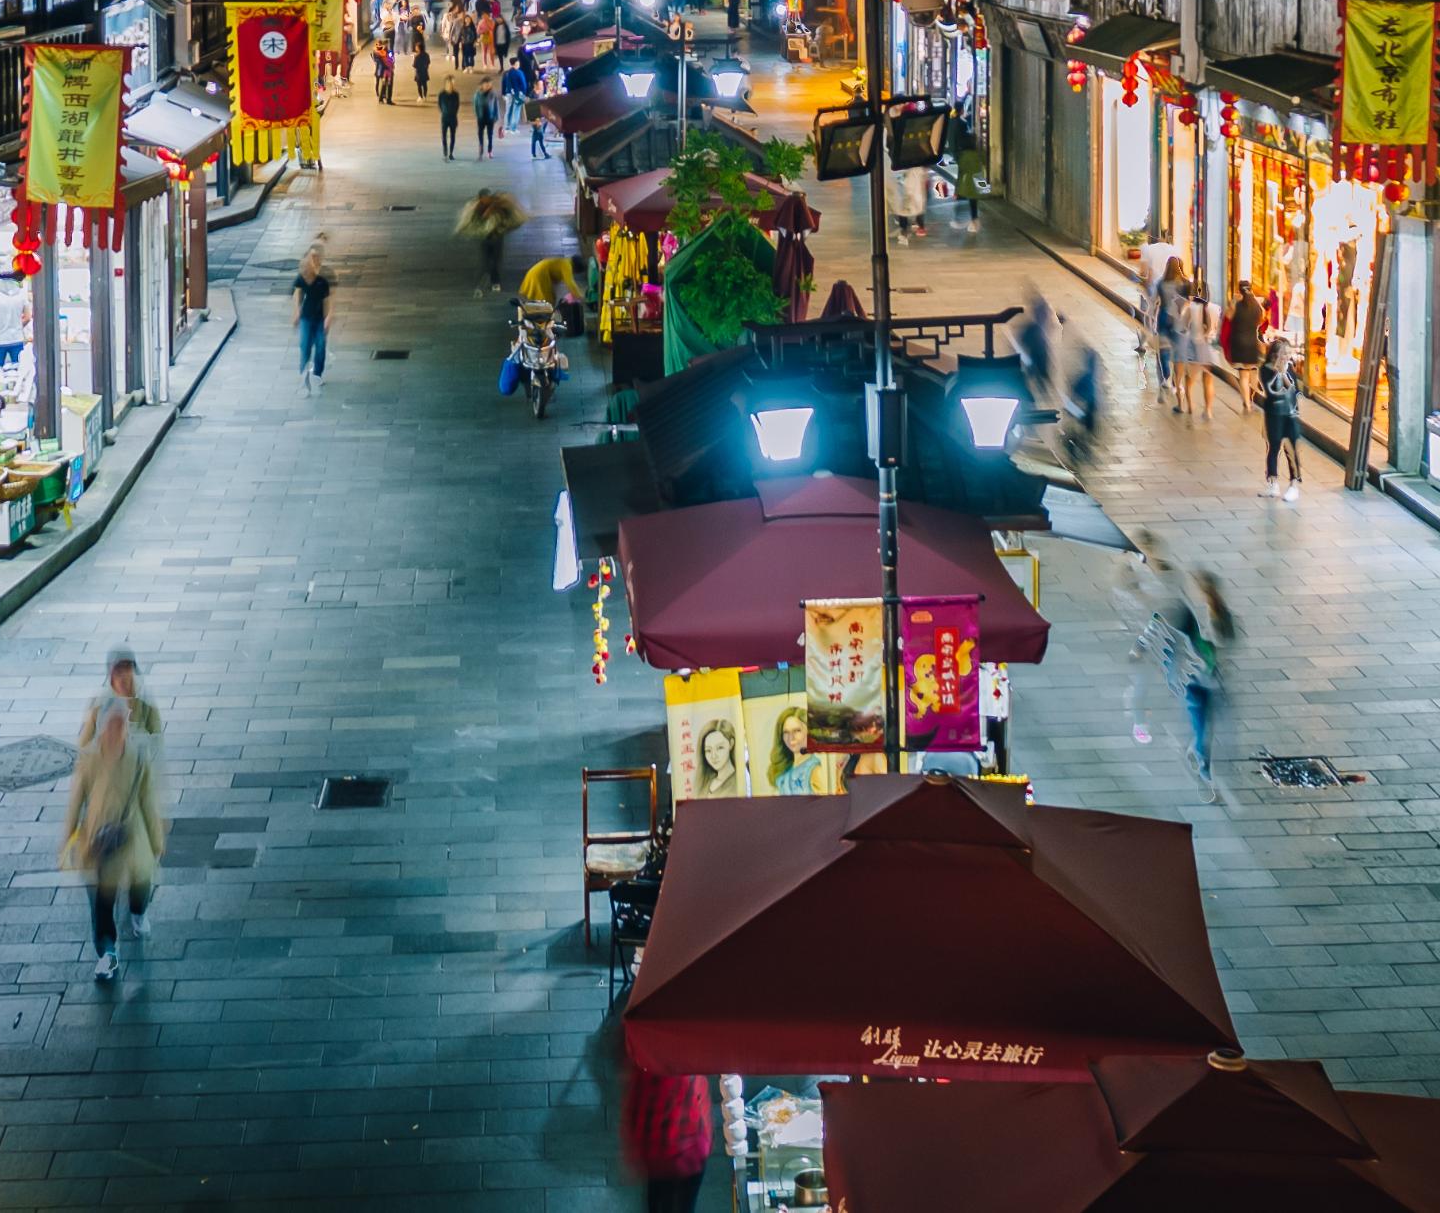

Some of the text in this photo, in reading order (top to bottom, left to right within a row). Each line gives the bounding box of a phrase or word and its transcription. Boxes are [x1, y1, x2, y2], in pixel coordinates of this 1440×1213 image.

[1371, 16, 1404, 130] 老北京布鞋
[923, 1038, 1044, 1065] 让心灵去旅行
